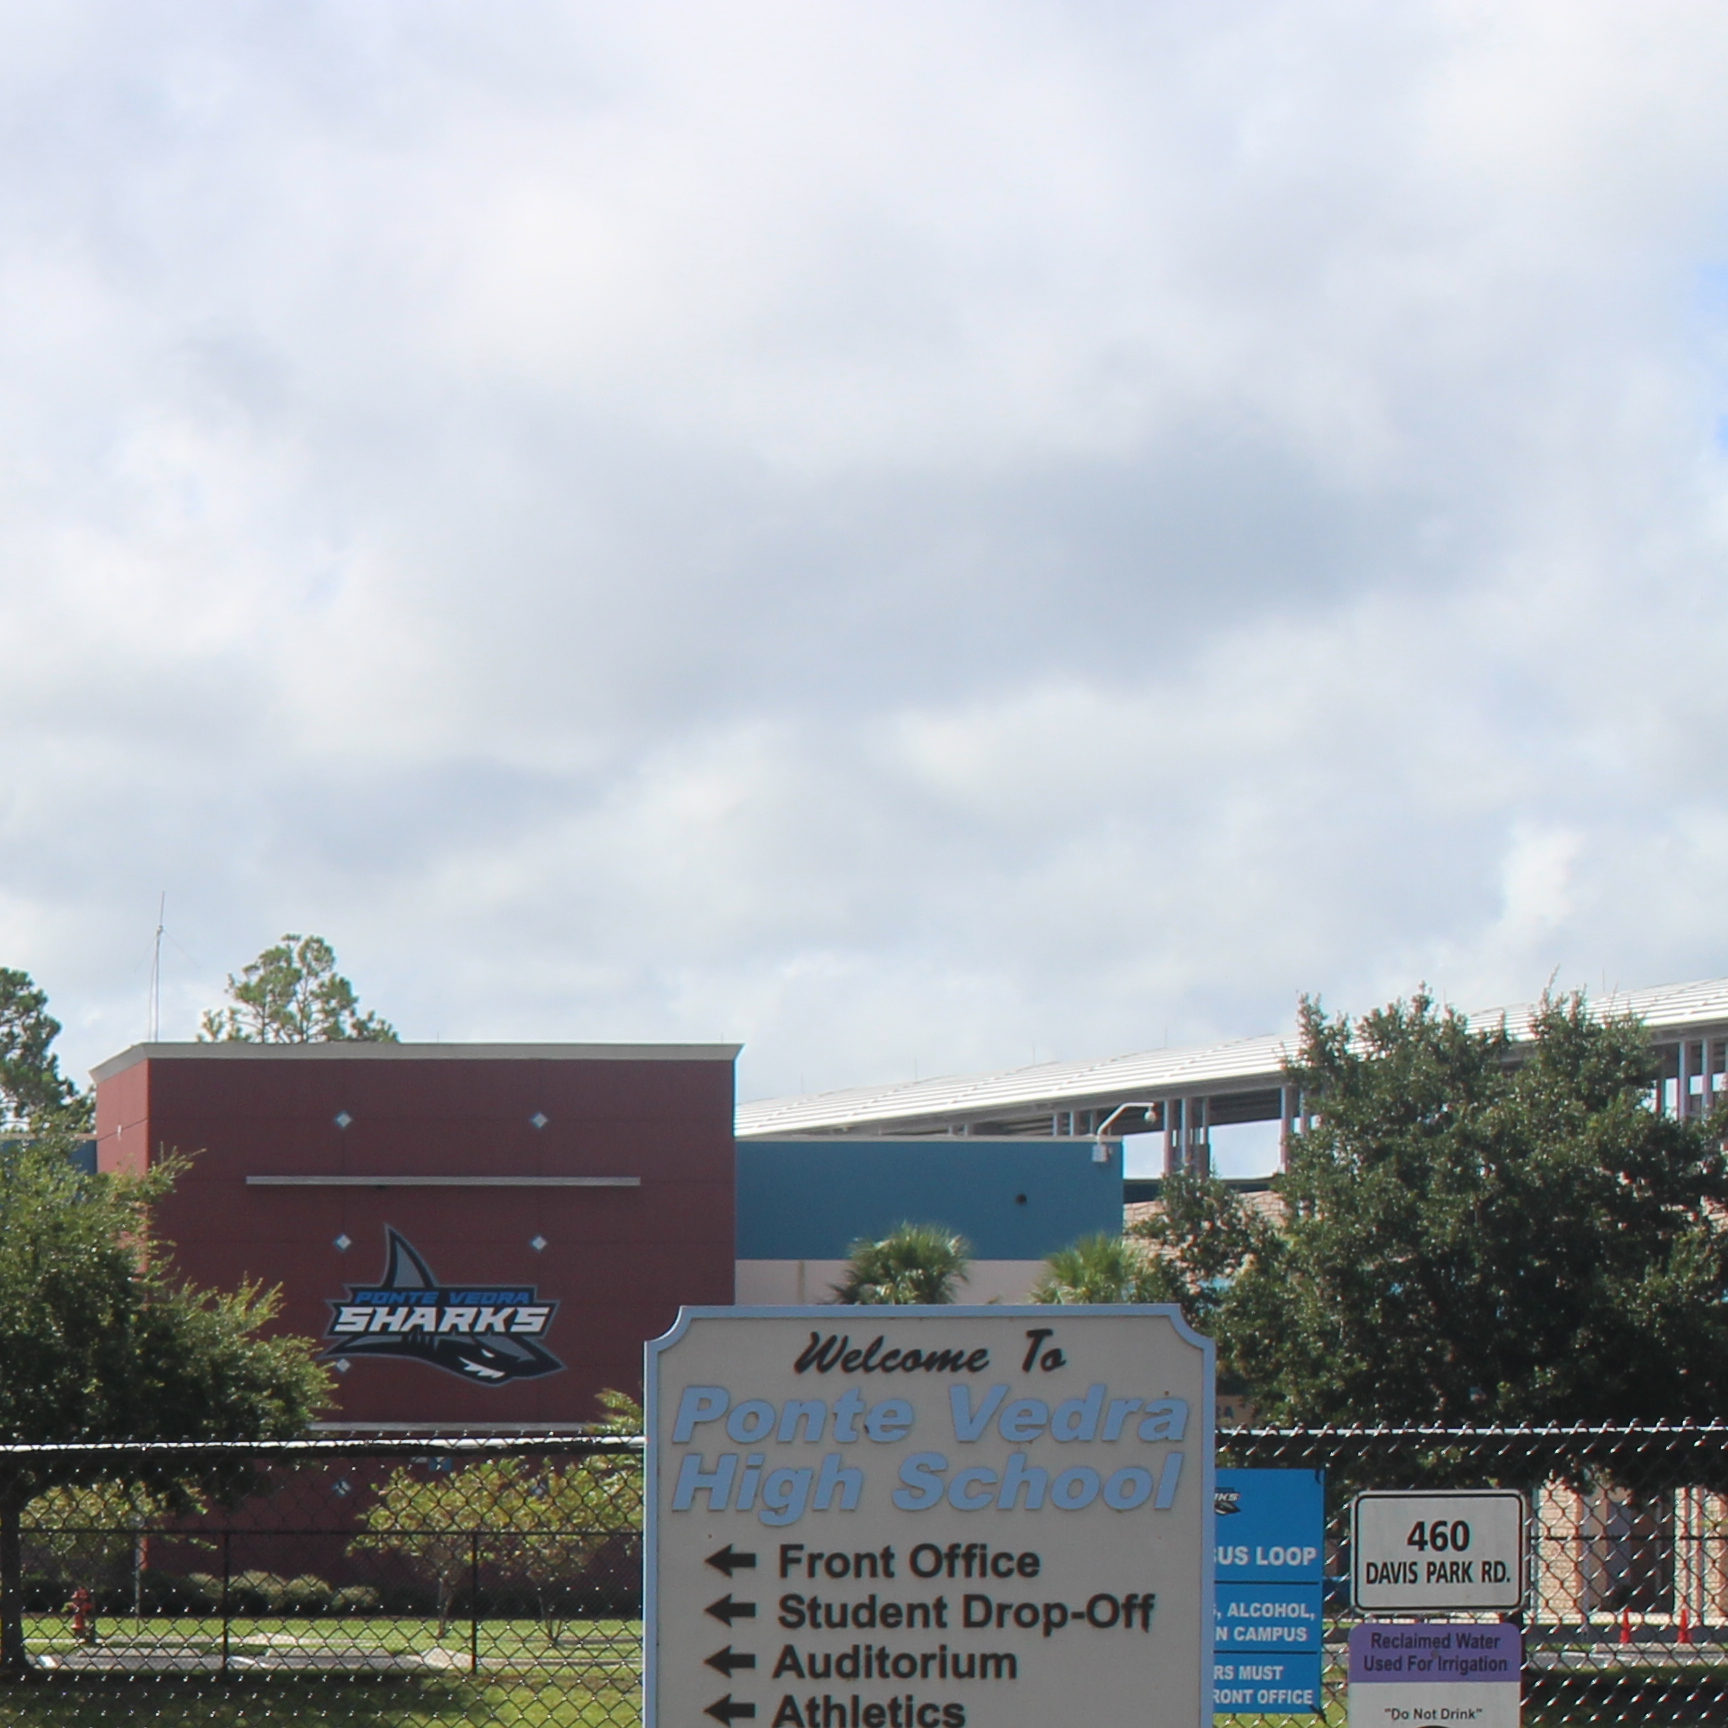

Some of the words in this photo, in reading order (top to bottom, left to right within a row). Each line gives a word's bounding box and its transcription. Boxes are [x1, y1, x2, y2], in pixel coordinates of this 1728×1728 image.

[354, 1291, 440, 1305] PONTE
[449, 1291, 532, 1305] VEDRA
[333, 1306, 551, 1332] SHARKS
[793, 1331, 990, 1374] Welcome
[1020, 1328, 1067, 1374] To
[671, 1384, 915, 1445] Ponte
[945, 1383, 1189, 1444] Vedra
[671, 1452, 867, 1527] High
[891, 1451, 1184, 1512] School
[1406, 1520, 1470, 1551] 460
[778, 1543, 896, 1579] Front
[909, 1542, 1042, 1579] Office
[1213, 1545, 1249, 1566] US
[1255, 1546, 1317, 1566] LOOP
[1365, 1561, 1418, 1584] DAVIS
[1426, 1560, 1474, 1583] PARK
[1481, 1560, 1511, 1583] RD.
[777, 1593, 949, 1630] Student
[961, 1592, 1157, 1637] Drop-Off
[1227, 1602, 1315, 1621] ALCOHOL,
[1233, 1626, 1308, 1642] CAMPUS
[1370, 1632, 1451, 1649] Reclaimed
[1455, 1632, 1501, 1649] Water
[772, 1643, 1019, 1680] Auditorium
[1364, 1655, 1403, 1672] Used
[1407, 1655, 1434, 1672] For
[1438, 1655, 1508, 1676] Irrigation
[1238, 1665, 1284, 1681] MUST
[1257, 1689, 1314, 1705] OFFICE
[1384, 1708, 1409, 1721] "Do
[1413, 1708, 1437, 1720] Not
[1440, 1707, 1483, 1720] Drink"
